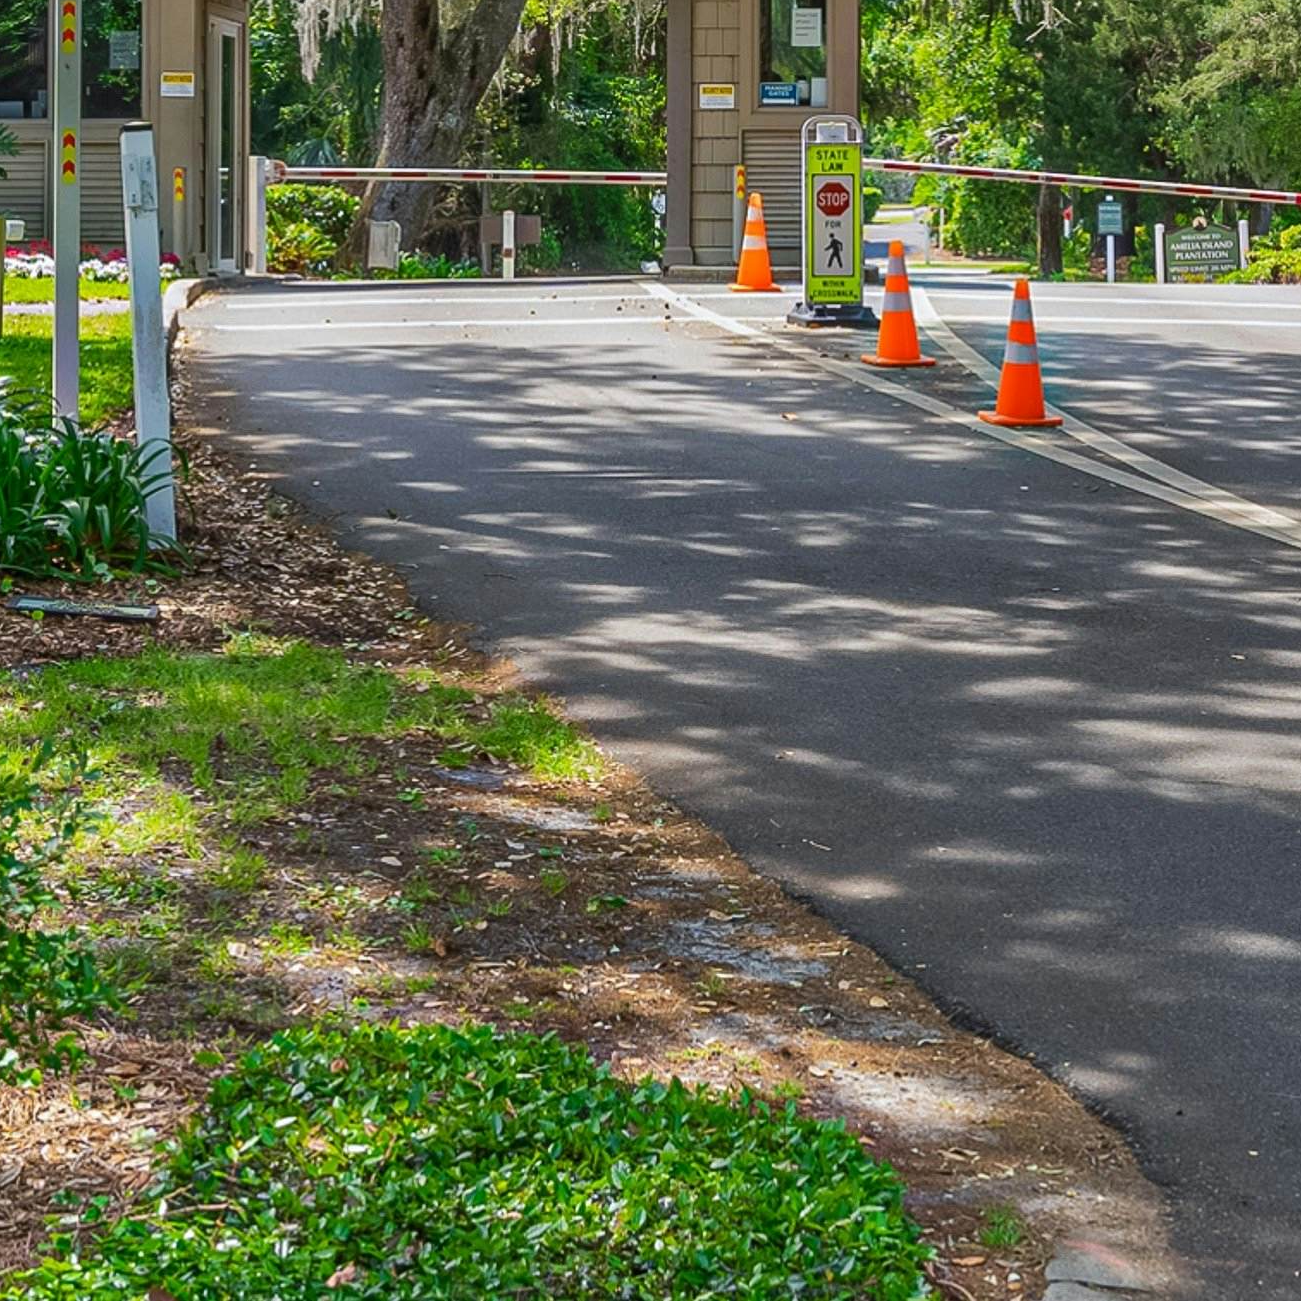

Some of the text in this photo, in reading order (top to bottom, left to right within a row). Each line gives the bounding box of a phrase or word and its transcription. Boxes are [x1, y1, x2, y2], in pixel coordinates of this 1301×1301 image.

[816, 149, 849, 160] STATE
[821, 163, 844, 172] LAW
[818, 192, 848, 206] STOP
[825, 220, 842, 229] FOR
[1171, 240, 1234, 251] AMELIA ISLAND
[1175, 251, 1228, 260] PLANTATION
[822, 280, 845, 288] WITHIN
[813, 290, 853, 298] CROSSWALK
